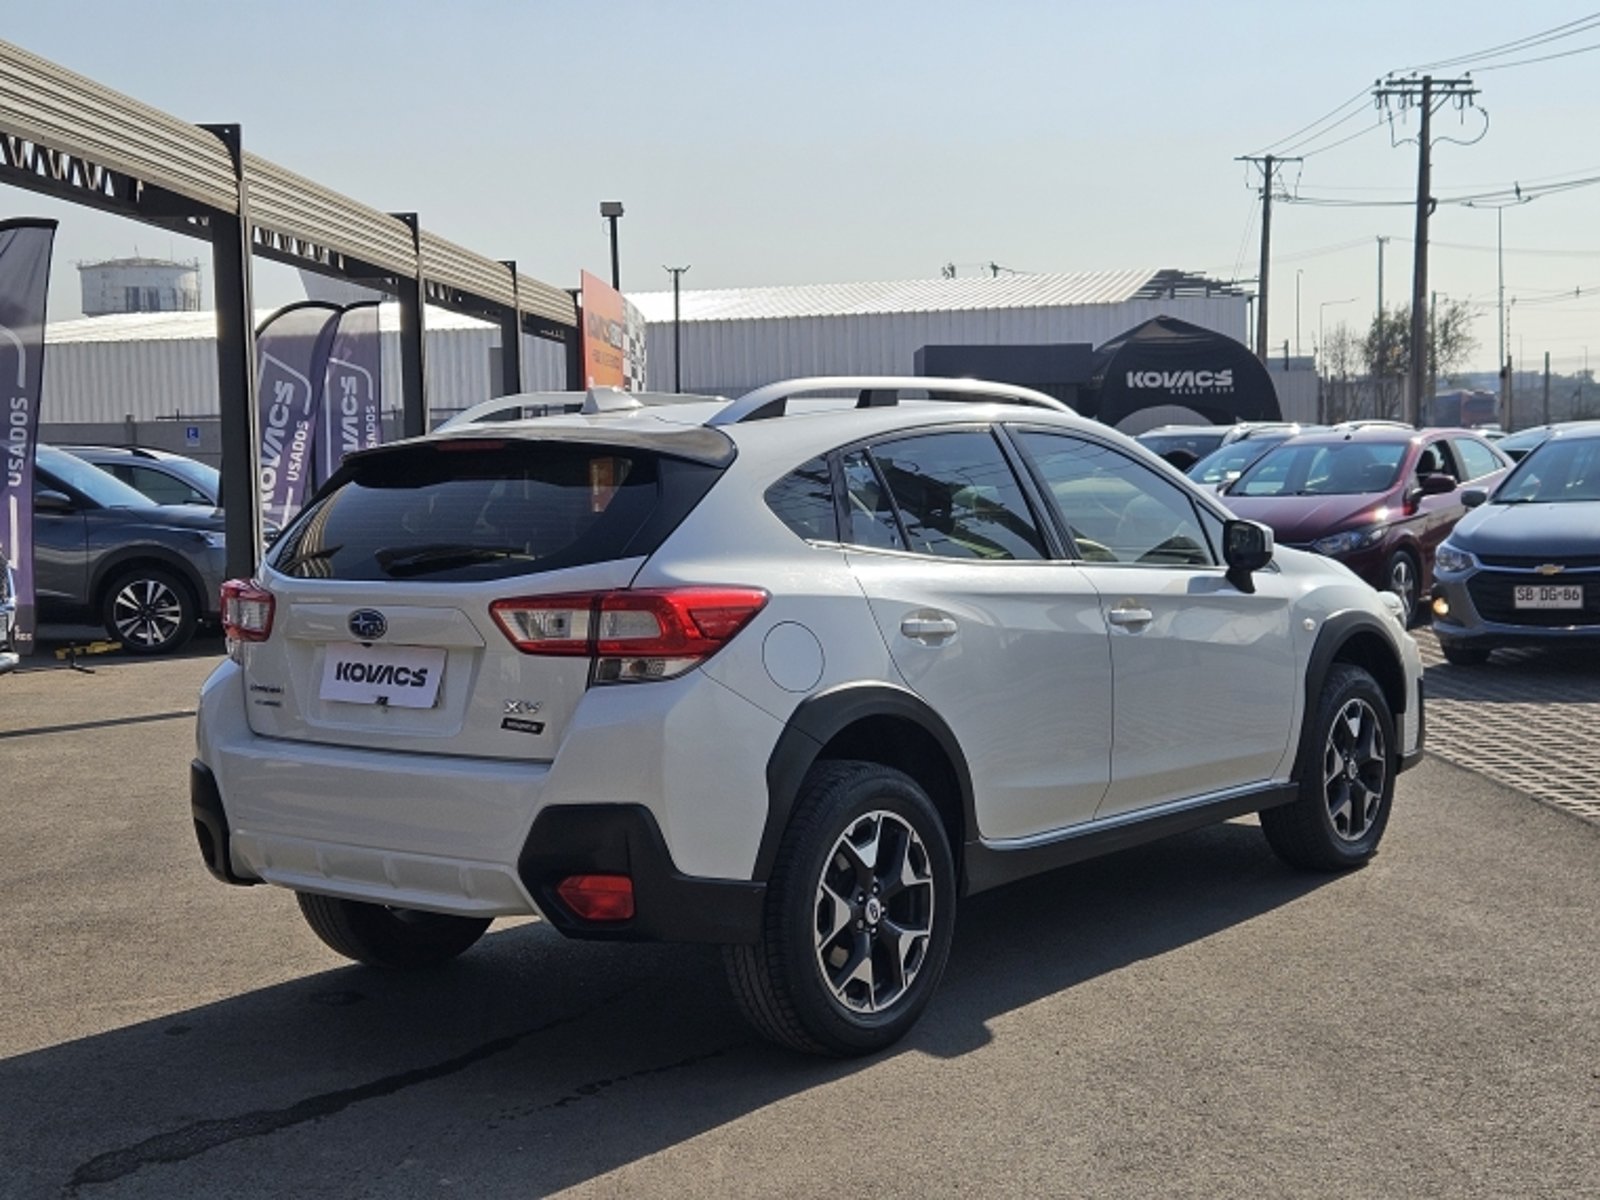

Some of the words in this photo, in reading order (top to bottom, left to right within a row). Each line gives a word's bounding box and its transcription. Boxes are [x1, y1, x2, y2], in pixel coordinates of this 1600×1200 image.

[1126, 369, 1233, 388] KOVACS
[340, 376, 359, 452] VACS
[365, 405, 378, 449] SADOS
[8, 397, 29, 487] USADOS
[286, 420, 309, 482] USADOS
[335, 661, 428, 687] KOVACS
